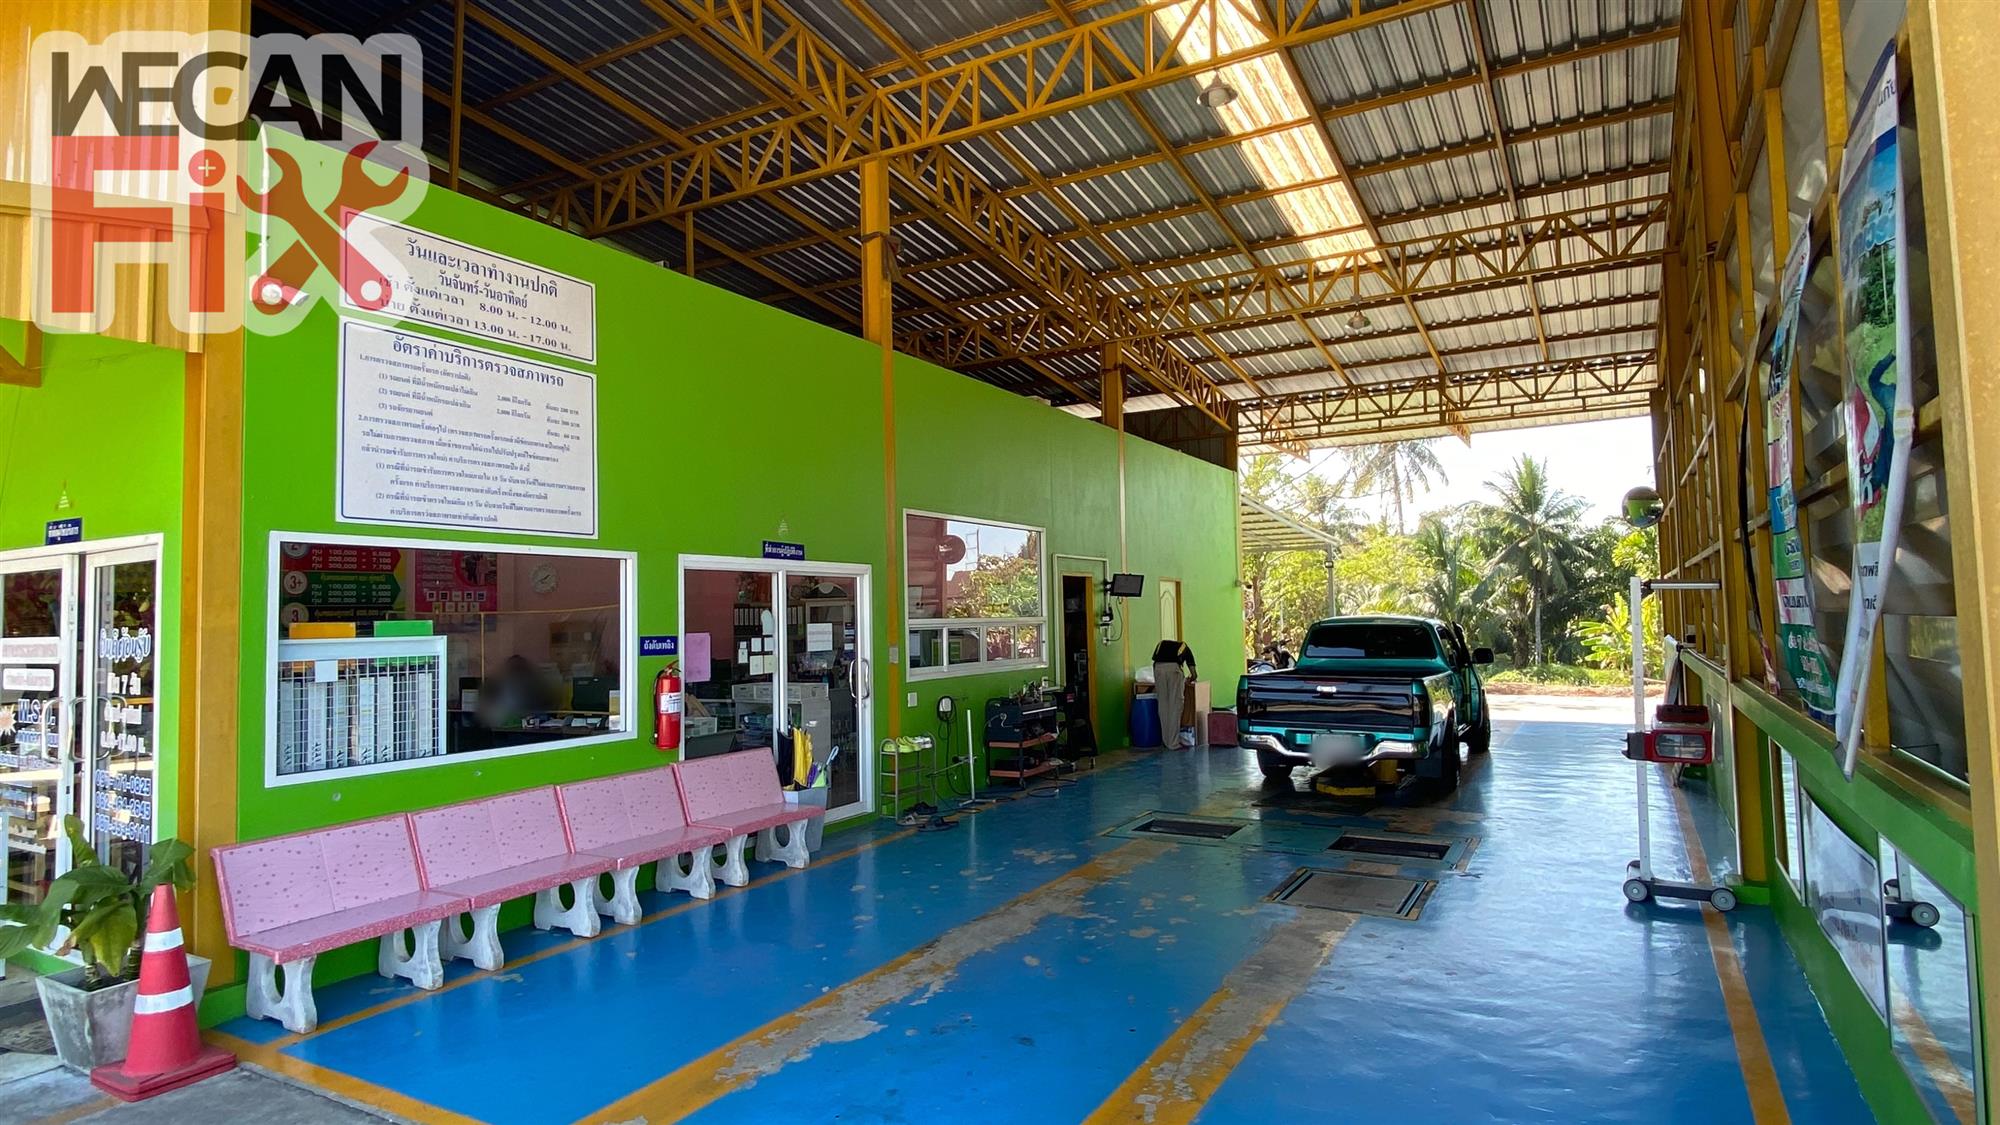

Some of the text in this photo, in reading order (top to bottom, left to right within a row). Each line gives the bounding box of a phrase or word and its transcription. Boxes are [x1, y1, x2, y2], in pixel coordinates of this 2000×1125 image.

[405, 237, 558, 298] วันและเวลาทำงานปกติ
[438, 269, 528, 308] วันจันทร์-วันอาทิตย์
[403, 276, 465, 306] ตั้งแต่เวลา
[479, 303, 503, 316] 8.00
[506, 310, 518, 320] น.
[530, 316, 557, 330] 12.00
[409, 297, 470, 327] ตั้งแต่เวลา
[474, 320, 504, 335] 13.00
[507, 328, 519, 339] น.
[530, 334, 557, 348] 17.00
[392, 335, 565, 388] อัตราค่าบริการตรวจสภาพรถ
[289, 575, 303, 589] 3+
